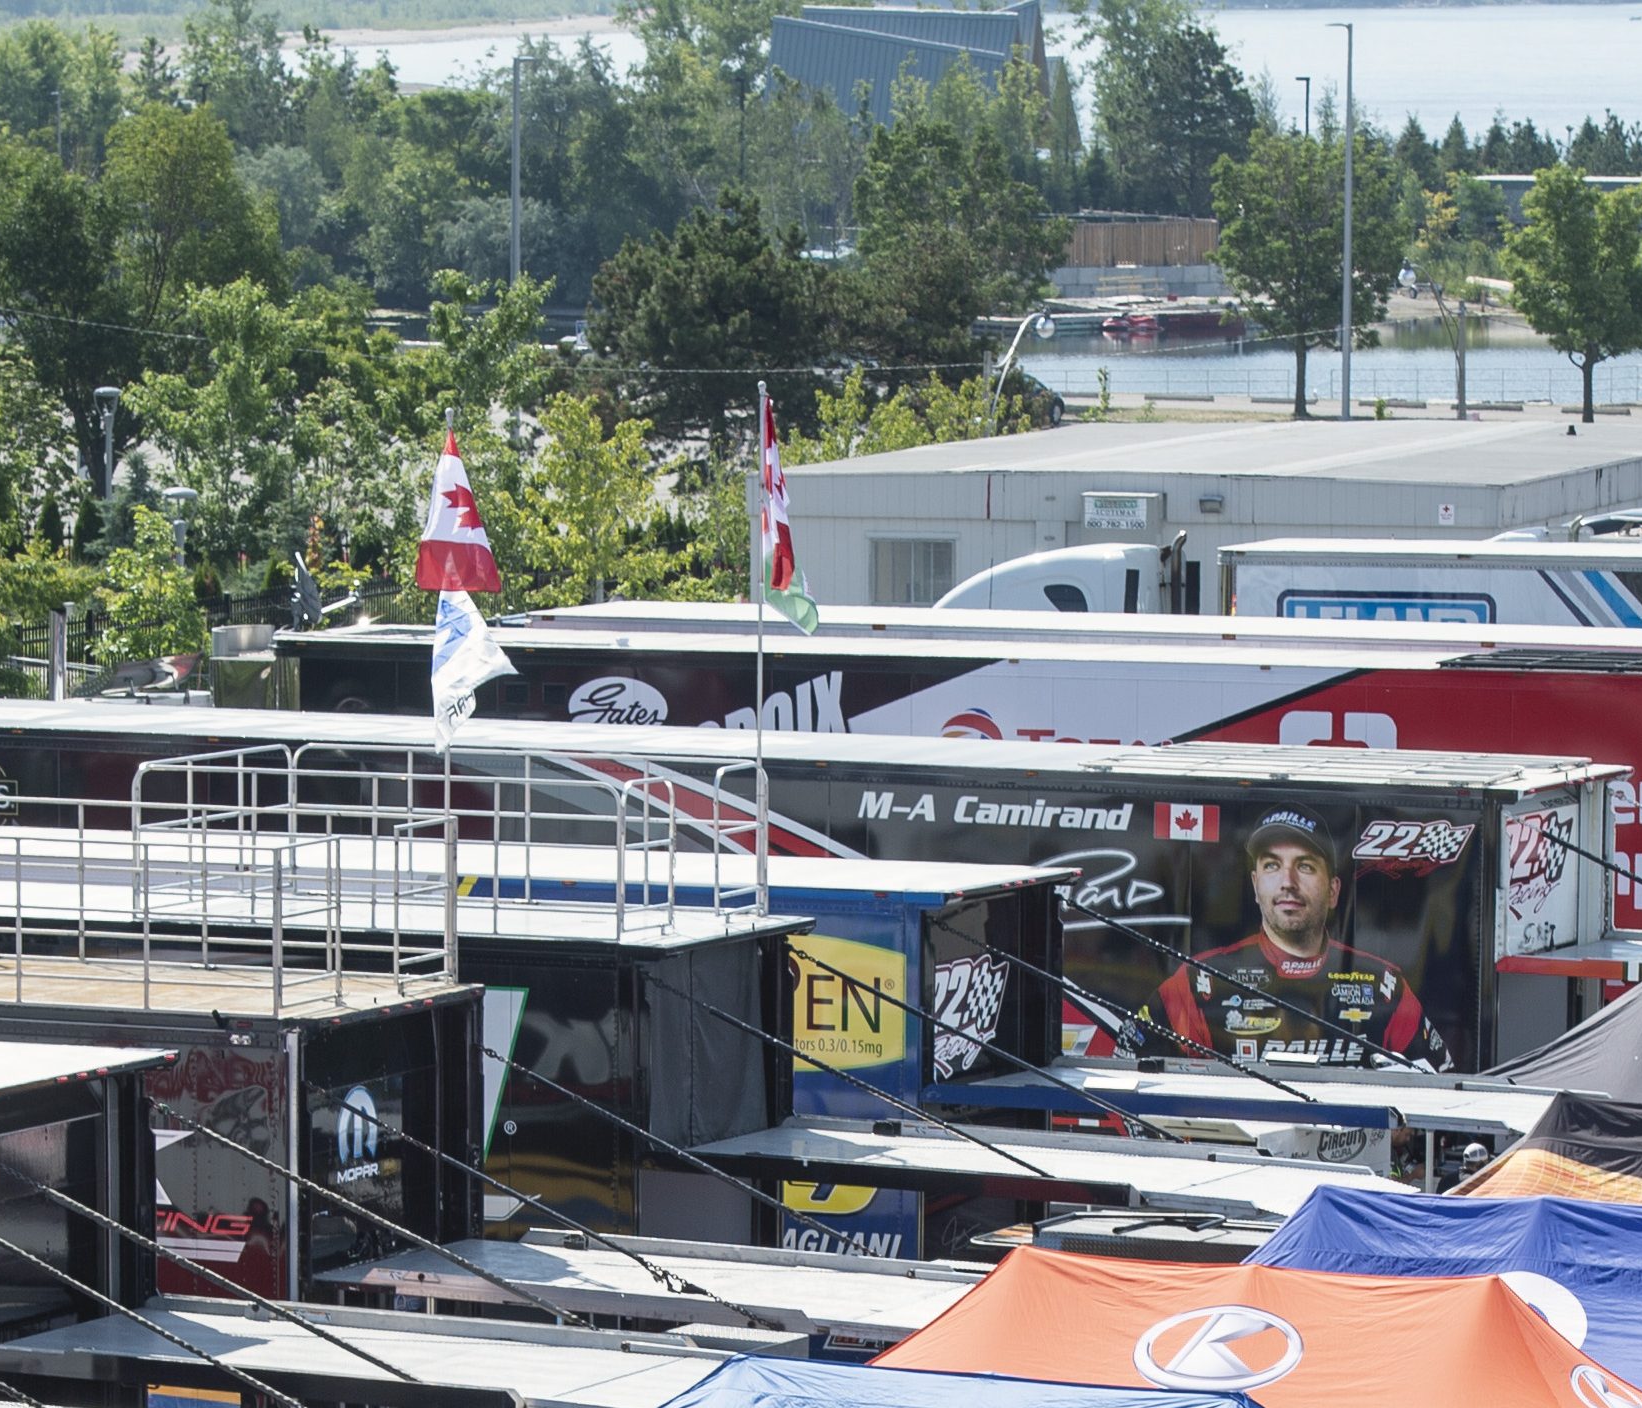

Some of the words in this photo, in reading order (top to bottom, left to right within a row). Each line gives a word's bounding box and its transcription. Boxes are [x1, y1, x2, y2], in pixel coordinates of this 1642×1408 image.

[579, 682, 665, 726] Gates
[953, 795, 1134, 832] Camirand
[1356, 823, 1421, 857] 22
[818, 1039, 883, 1058] 0.3/0.15mg
[337, 1165, 380, 1184] MOPAR
